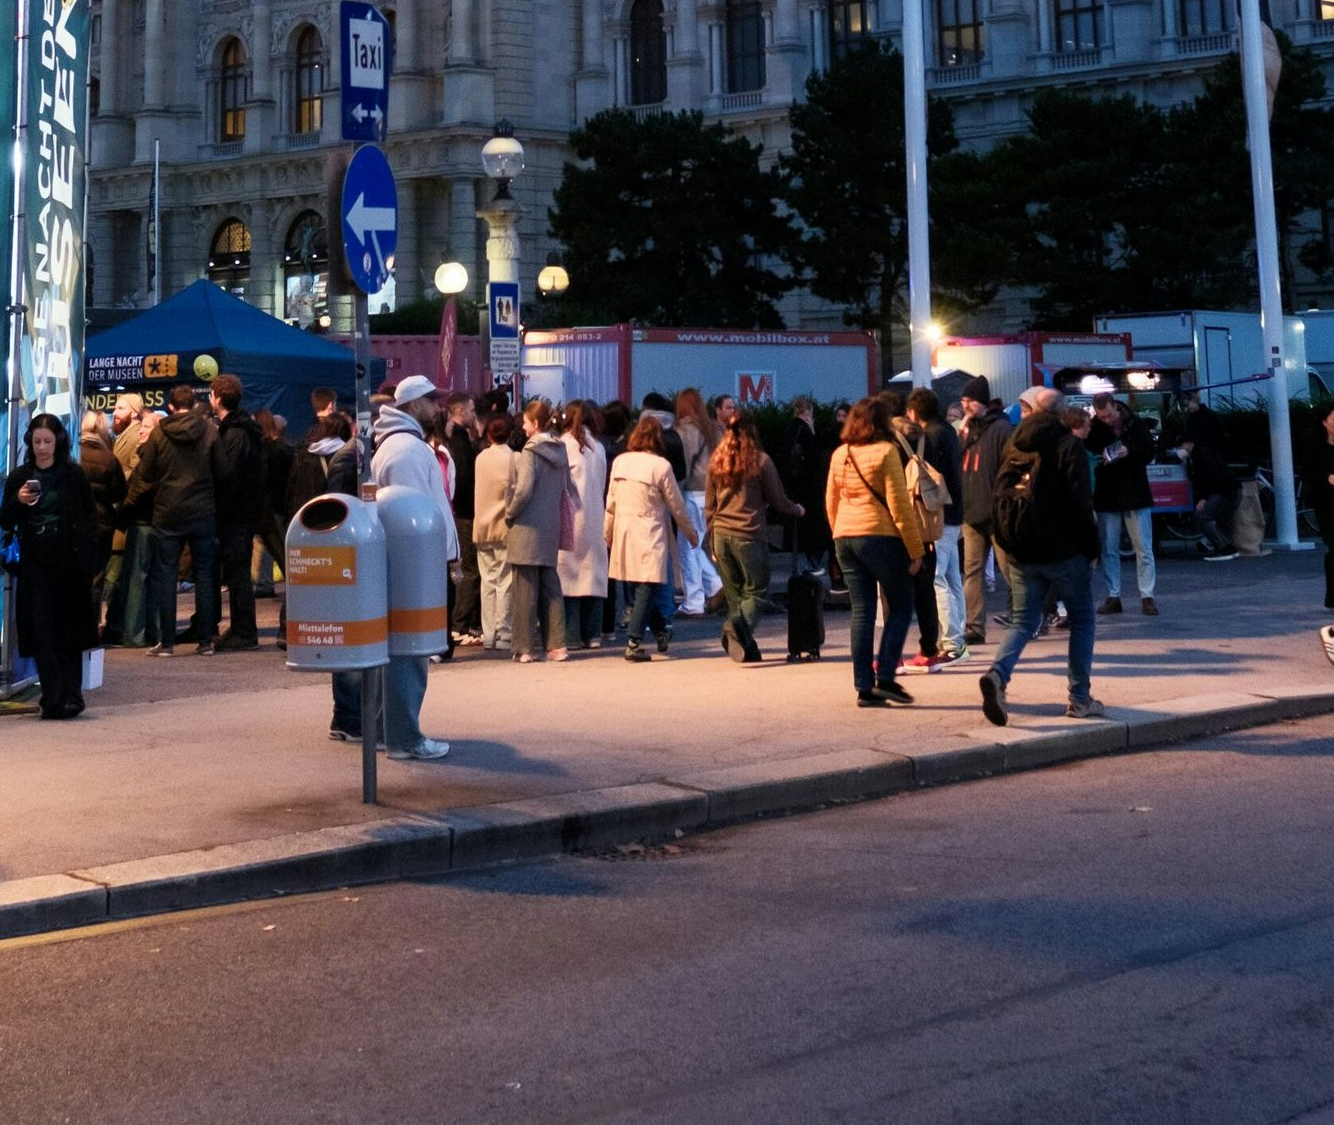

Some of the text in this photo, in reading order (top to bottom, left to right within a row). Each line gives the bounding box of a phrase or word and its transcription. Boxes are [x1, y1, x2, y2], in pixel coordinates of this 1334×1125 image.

[352, 33, 382, 71] Taxi
[35, 78, 53, 283] NACHT
[677, 332, 830, 344] www.mobilbox.at
[88, 355, 144, 369] LANGE NACHT
[88, 367, 143, 381] DER MUSEEN
[289, 557, 332, 566] SCHMECKT'S
[289, 566, 307, 574] HALT!
[298, 623, 344, 633] Misttelefon
[306, 636, 334, 645] 546 48
